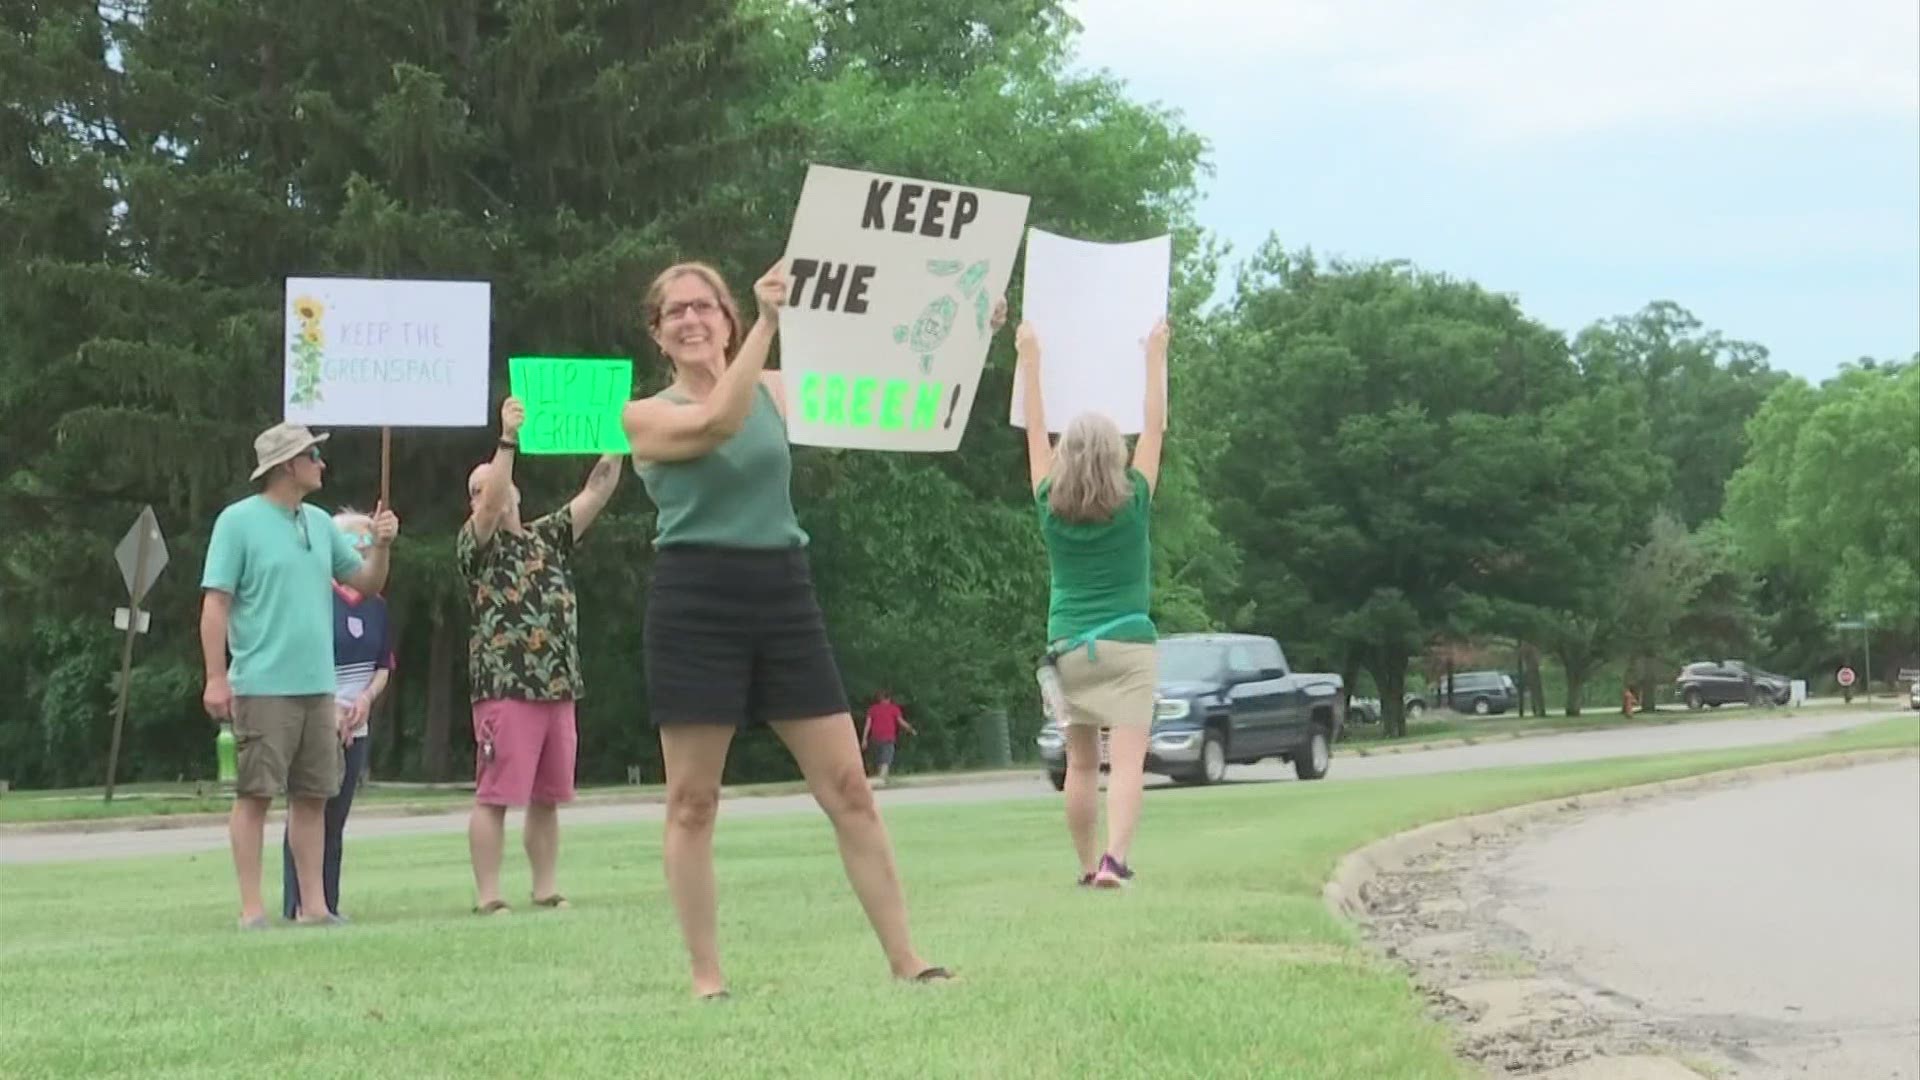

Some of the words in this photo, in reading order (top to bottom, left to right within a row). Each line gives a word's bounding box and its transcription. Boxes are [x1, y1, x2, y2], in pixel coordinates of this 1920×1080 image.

[861, 179, 979, 240] KEEP
[788, 258, 877, 315] THE
[339, 321, 392, 347] KEEP
[401, 321, 446, 348] THE
[324, 357, 456, 387] GREENSPACE
